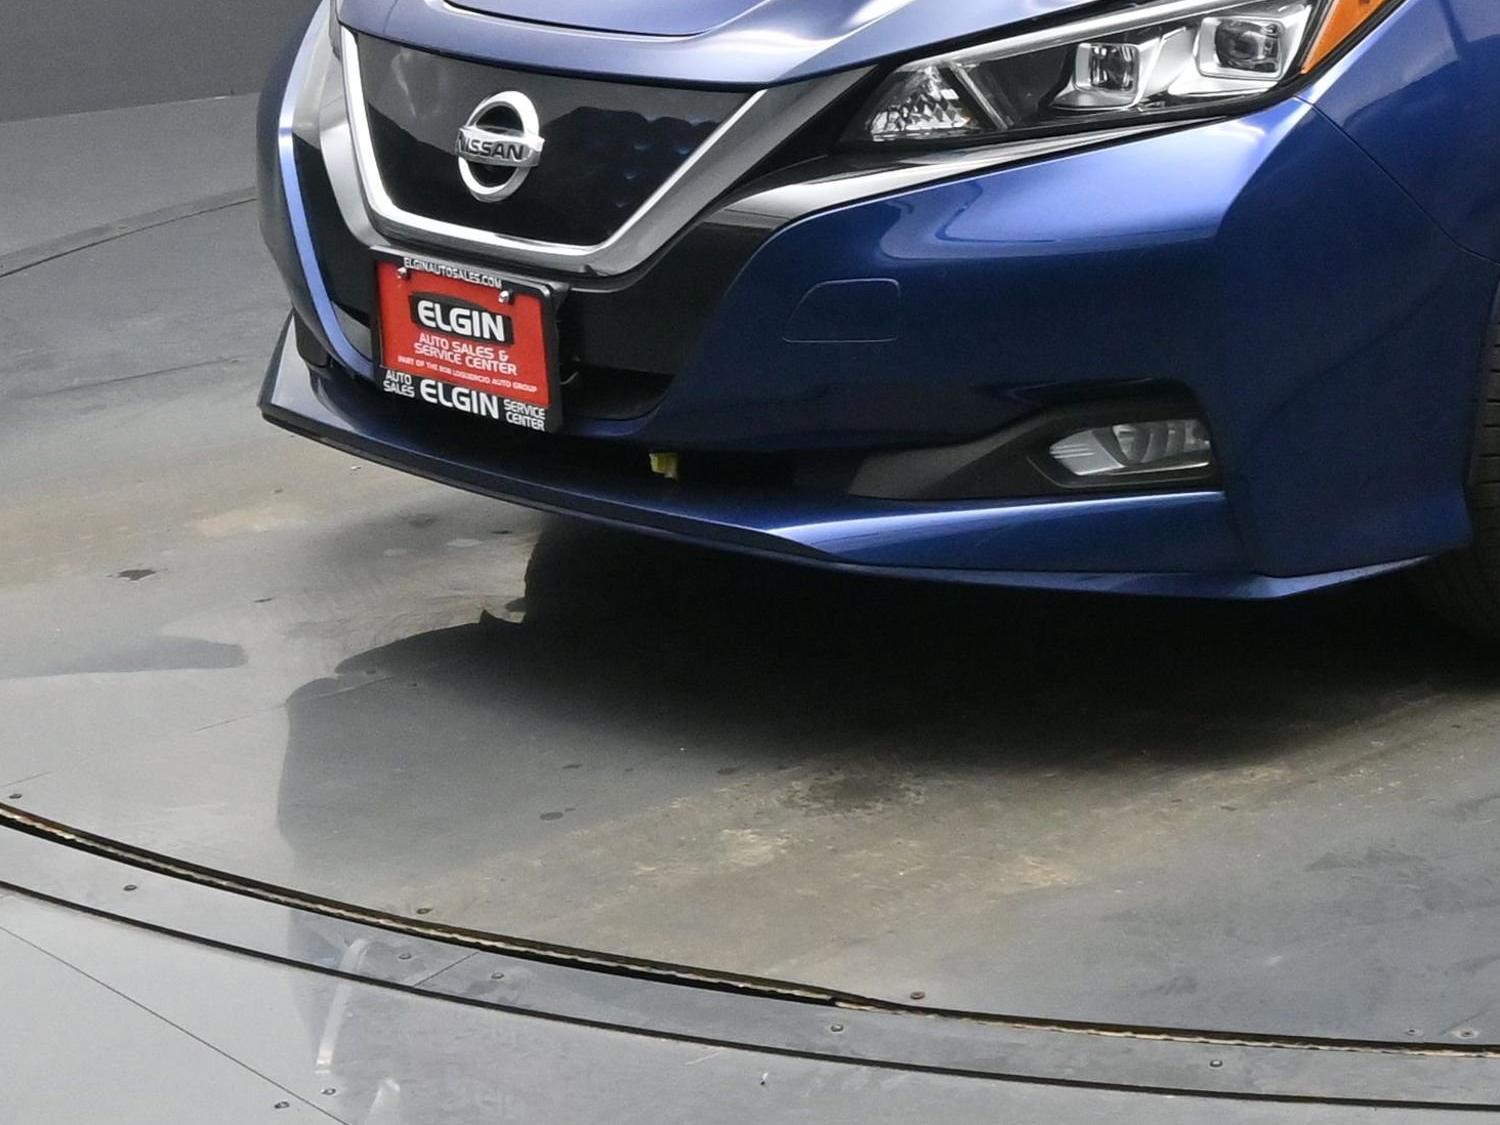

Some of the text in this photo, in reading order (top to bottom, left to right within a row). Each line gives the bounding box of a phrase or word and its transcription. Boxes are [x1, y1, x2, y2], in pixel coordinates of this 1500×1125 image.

[459, 134, 524, 160] NISSAN
[403, 257, 502, 289] ELGINAUTOSALES.COM
[417, 300, 505, 342] ELGIN
[414, 342, 517, 377] SERVICE CENTER
[418, 332, 509, 362] AUTO SALES &
[383, 380, 415, 398] SALES
[386, 370, 412, 385] AUTO
[420, 379, 500, 420] ELGIN
[503, 399, 546, 420] SERVICE
[505, 411, 545, 432] CENTER
